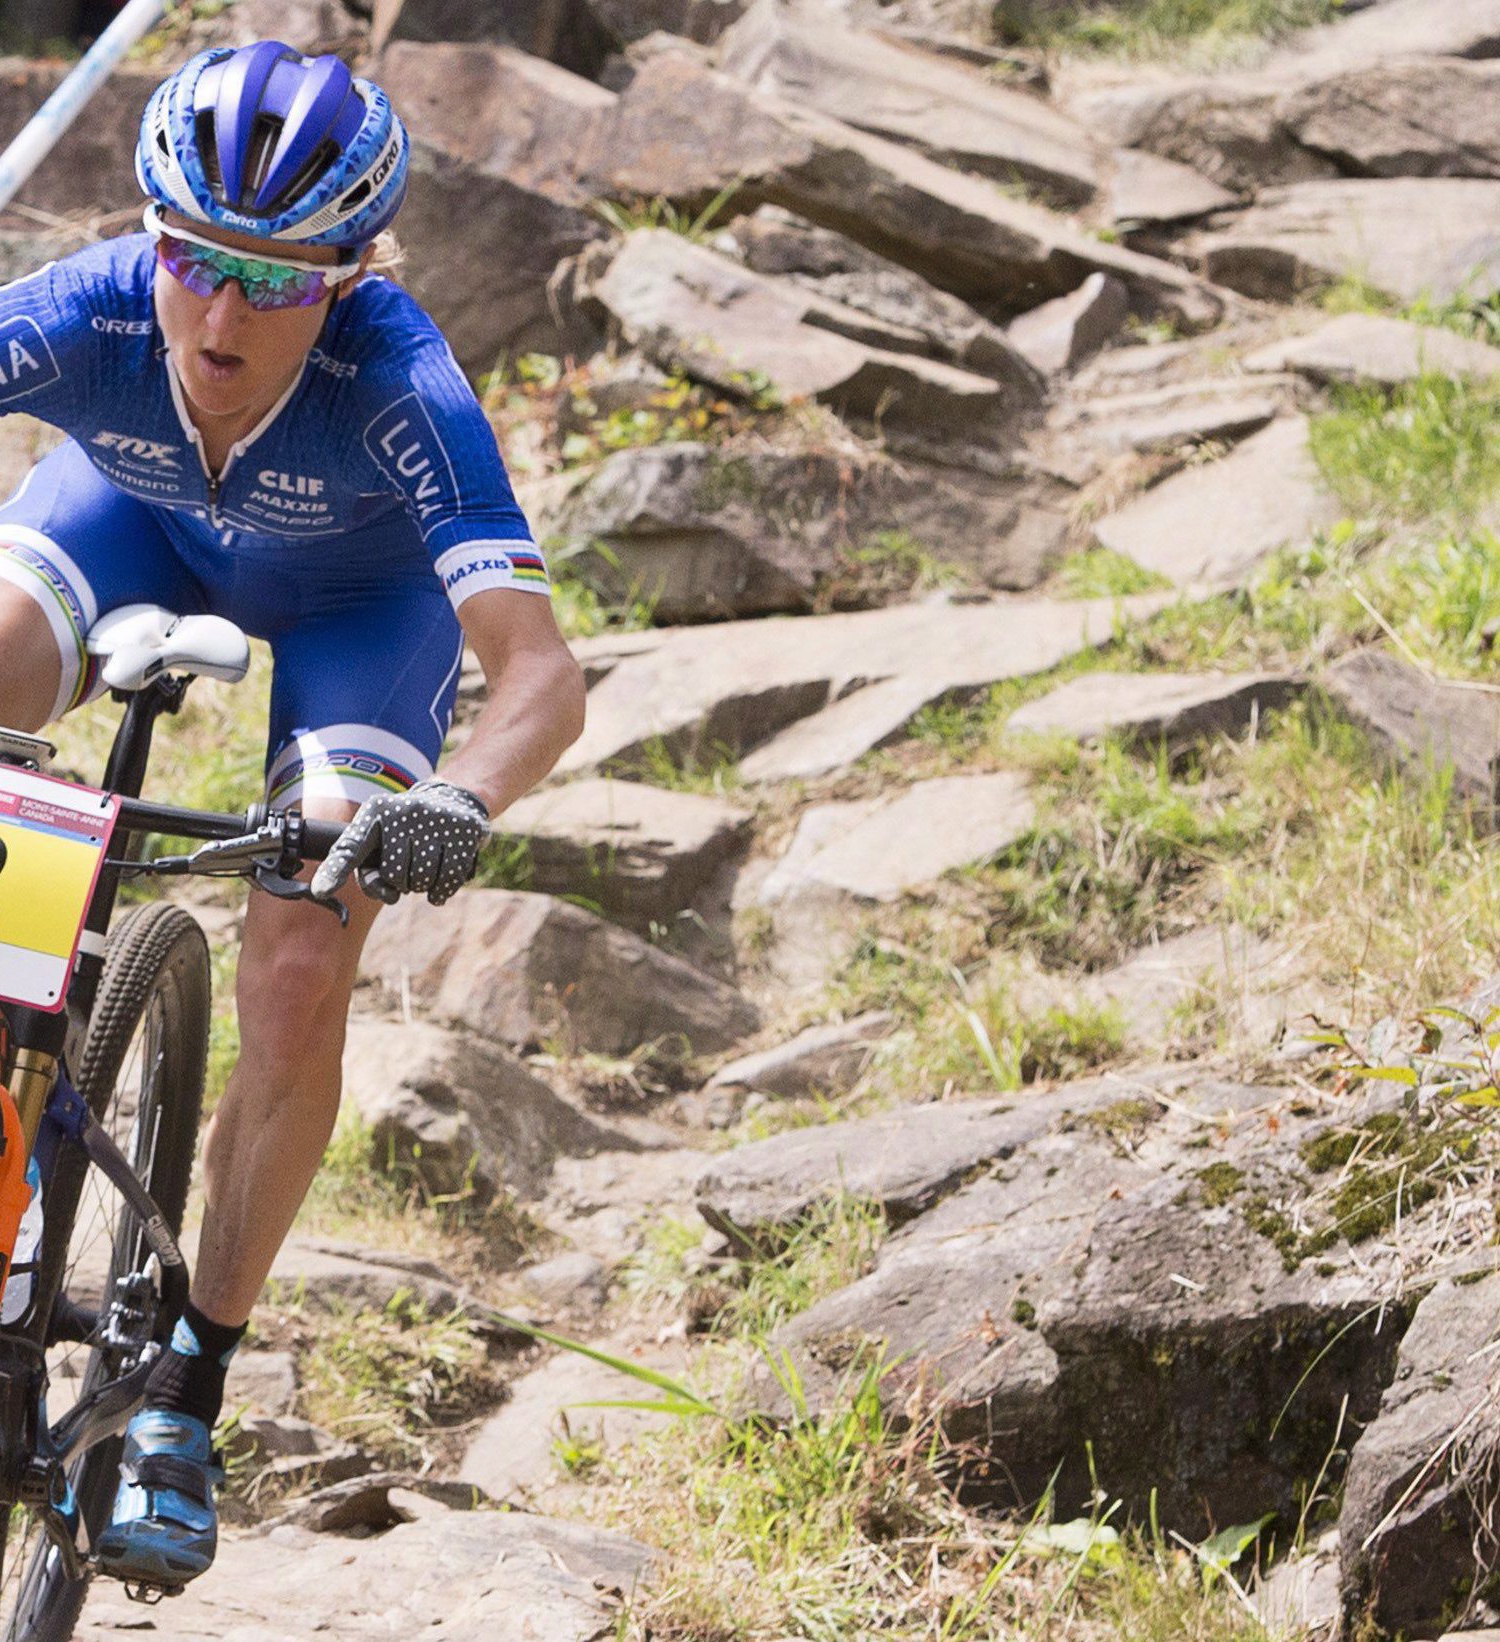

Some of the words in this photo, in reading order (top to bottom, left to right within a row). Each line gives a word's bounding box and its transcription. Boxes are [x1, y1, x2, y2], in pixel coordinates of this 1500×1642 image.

[372, 139, 399, 186] GIRO
[91, 431, 183, 470] FOX
[258, 469, 324, 497] CLIF
[249, 490, 328, 512] MAXXIS
